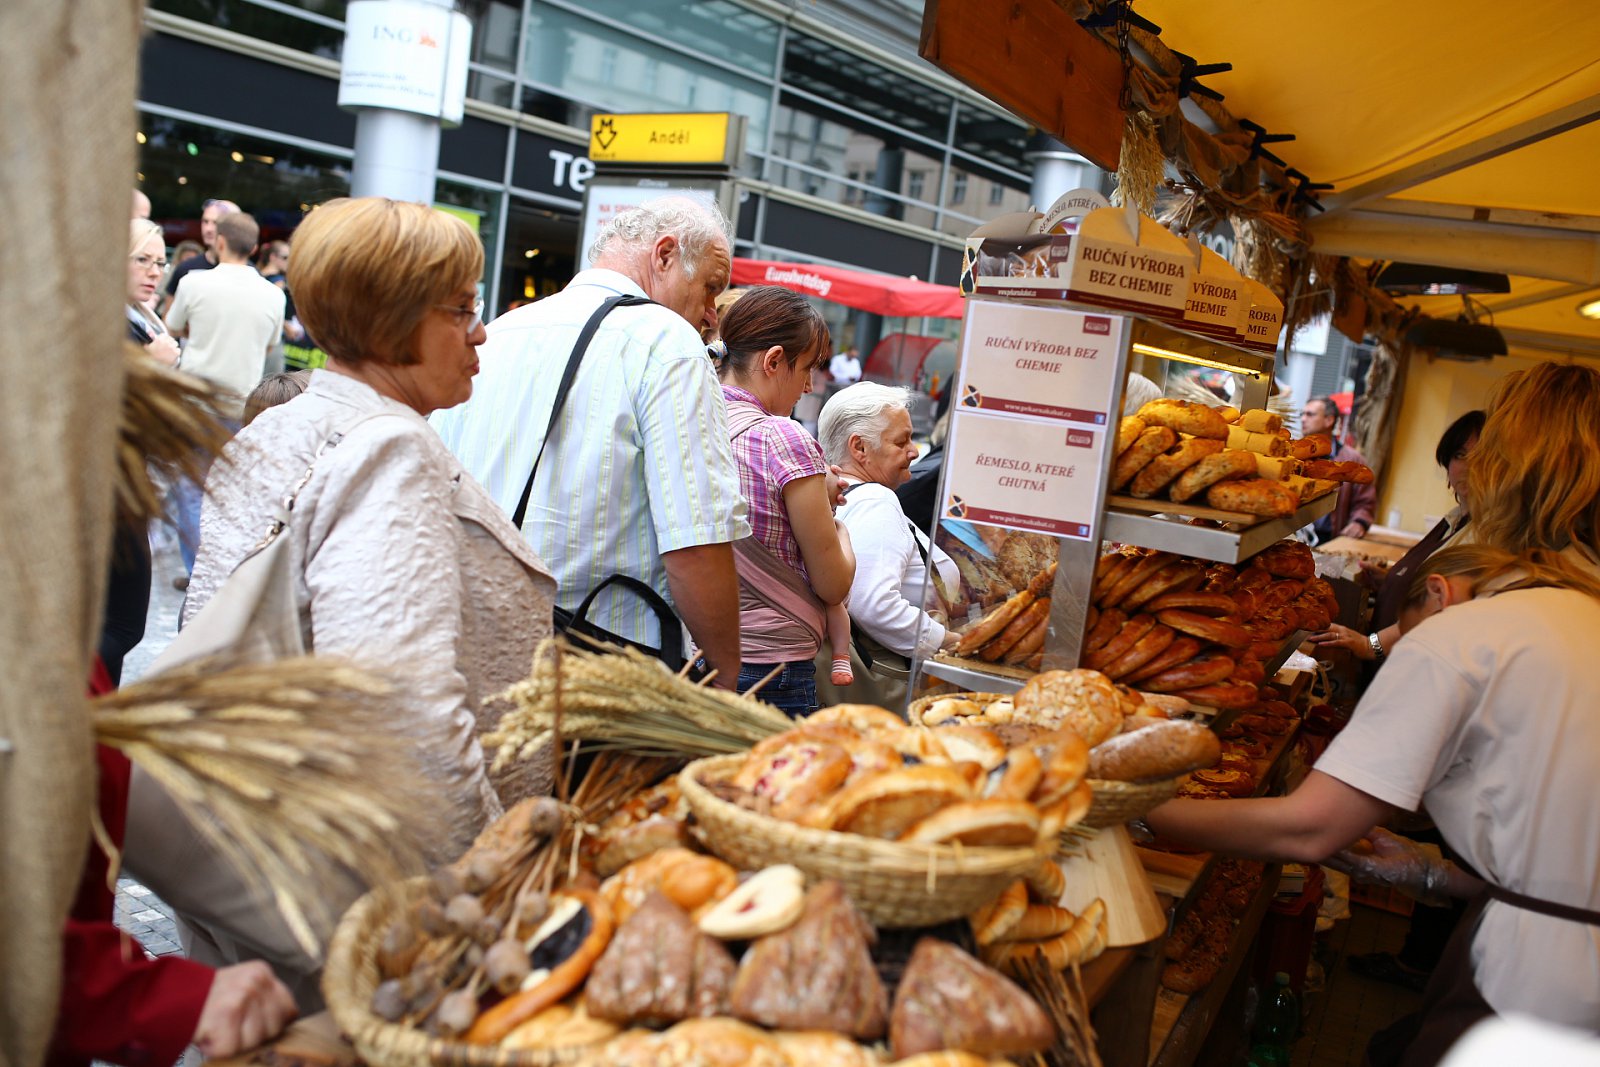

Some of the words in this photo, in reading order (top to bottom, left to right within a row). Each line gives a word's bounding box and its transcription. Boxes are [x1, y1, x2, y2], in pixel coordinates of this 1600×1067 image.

[373, 25, 412, 42] ING
[648, 129, 690, 144] Anděl
[1082, 246, 1126, 267] RUČNÍ
[1130, 252, 1185, 278] VÝROBA
[1089, 269, 1116, 285] BEZ
[1119, 275, 1174, 297] CHEMIE
[1193, 281, 1238, 300] VÝROBA
[1185, 300, 1228, 317] CHEMIE
[985, 336, 1023, 350] RUČNÍ
[1024, 340, 1071, 357] VÝROBA
[1074, 347, 1099, 359] BEZ
[1015, 358, 1062, 373] CHEMIE
[975, 453, 1032, 473] ŘEMESLO,
[1034, 463, 1076, 478] KTERÉ
[998, 476, 1047, 492] CHUTNÁ
